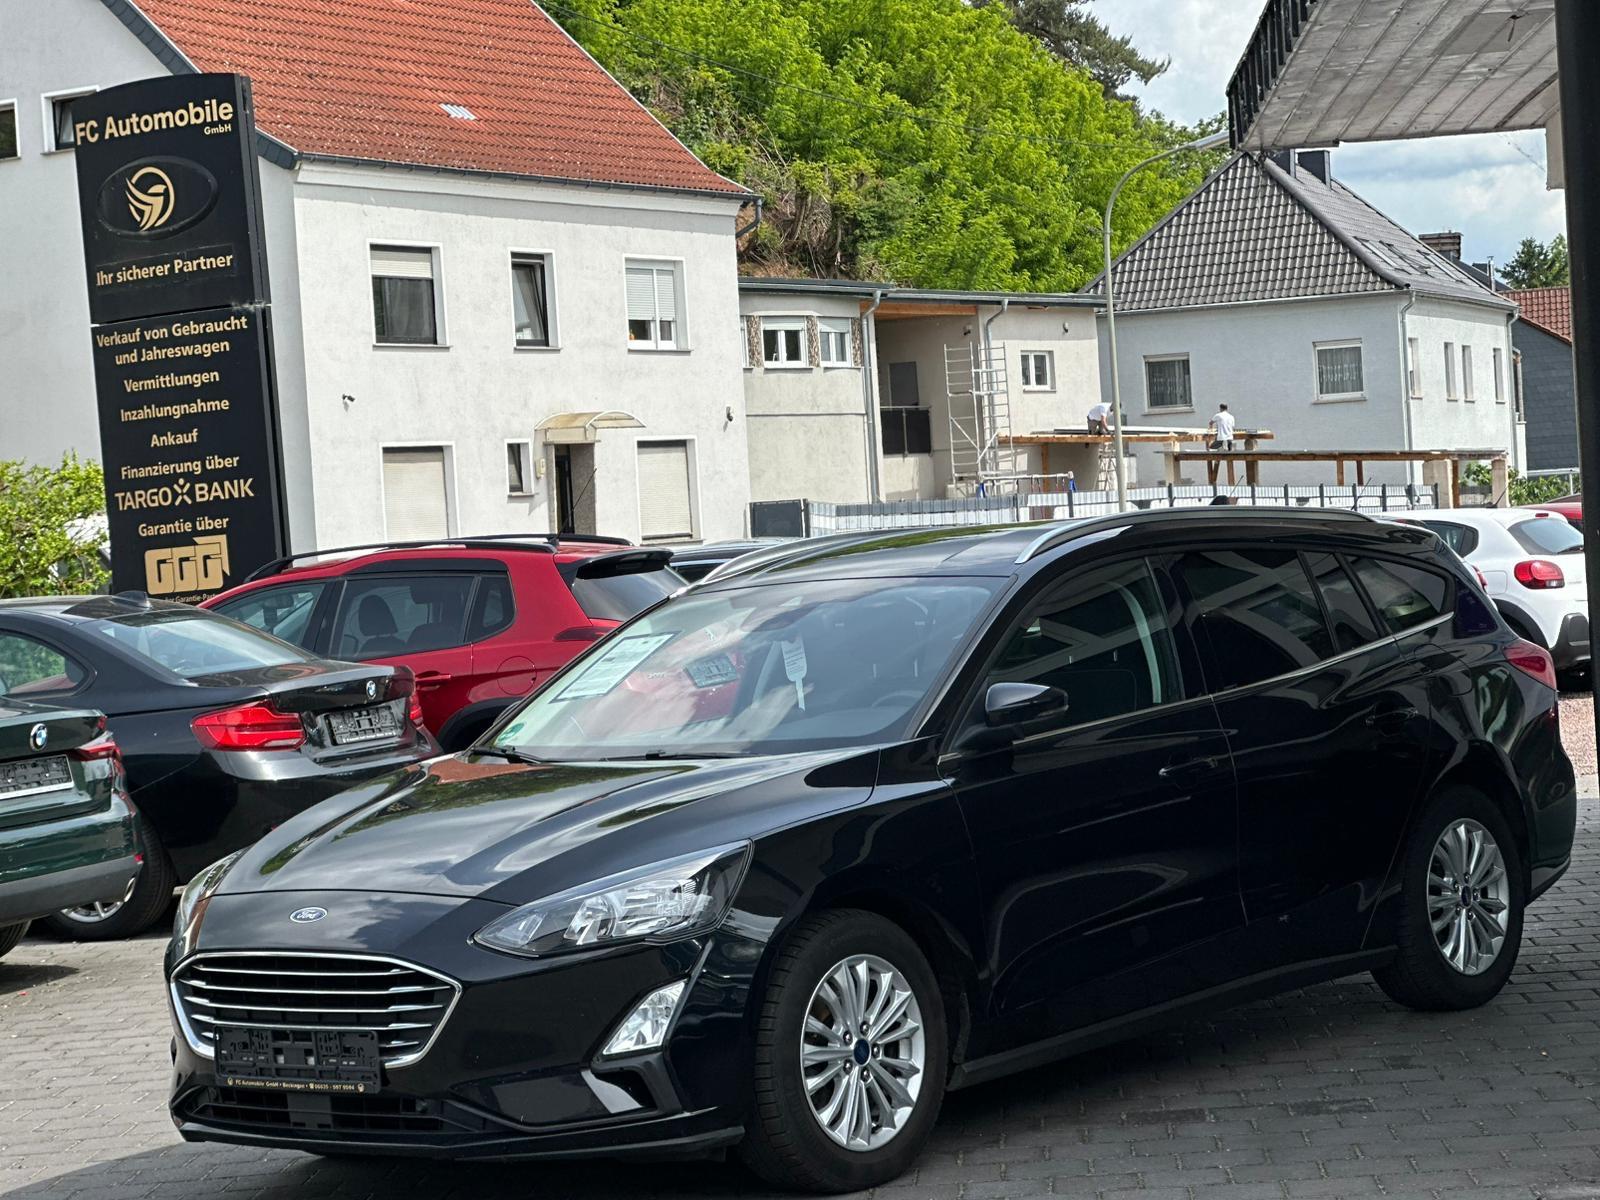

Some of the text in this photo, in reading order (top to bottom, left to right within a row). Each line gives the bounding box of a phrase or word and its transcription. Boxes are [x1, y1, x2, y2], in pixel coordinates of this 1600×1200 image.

[75, 99, 234, 146] FC Automobile
[203, 123, 232, 136] GmbH
[96, 254, 233, 287] Ihr sicherer Partner
[96, 315, 248, 348] Verkauf von Gebraucht
[115, 340, 231, 365] und Jahreswagen
[123, 370, 220, 393] Vermittlungen
[120, 398, 230, 422] Inzahlungnahme
[150, 428, 199, 448] Ankauf
[121, 455, 240, 480] Finanzierung über
[138, 516, 230, 537] Garantie über
